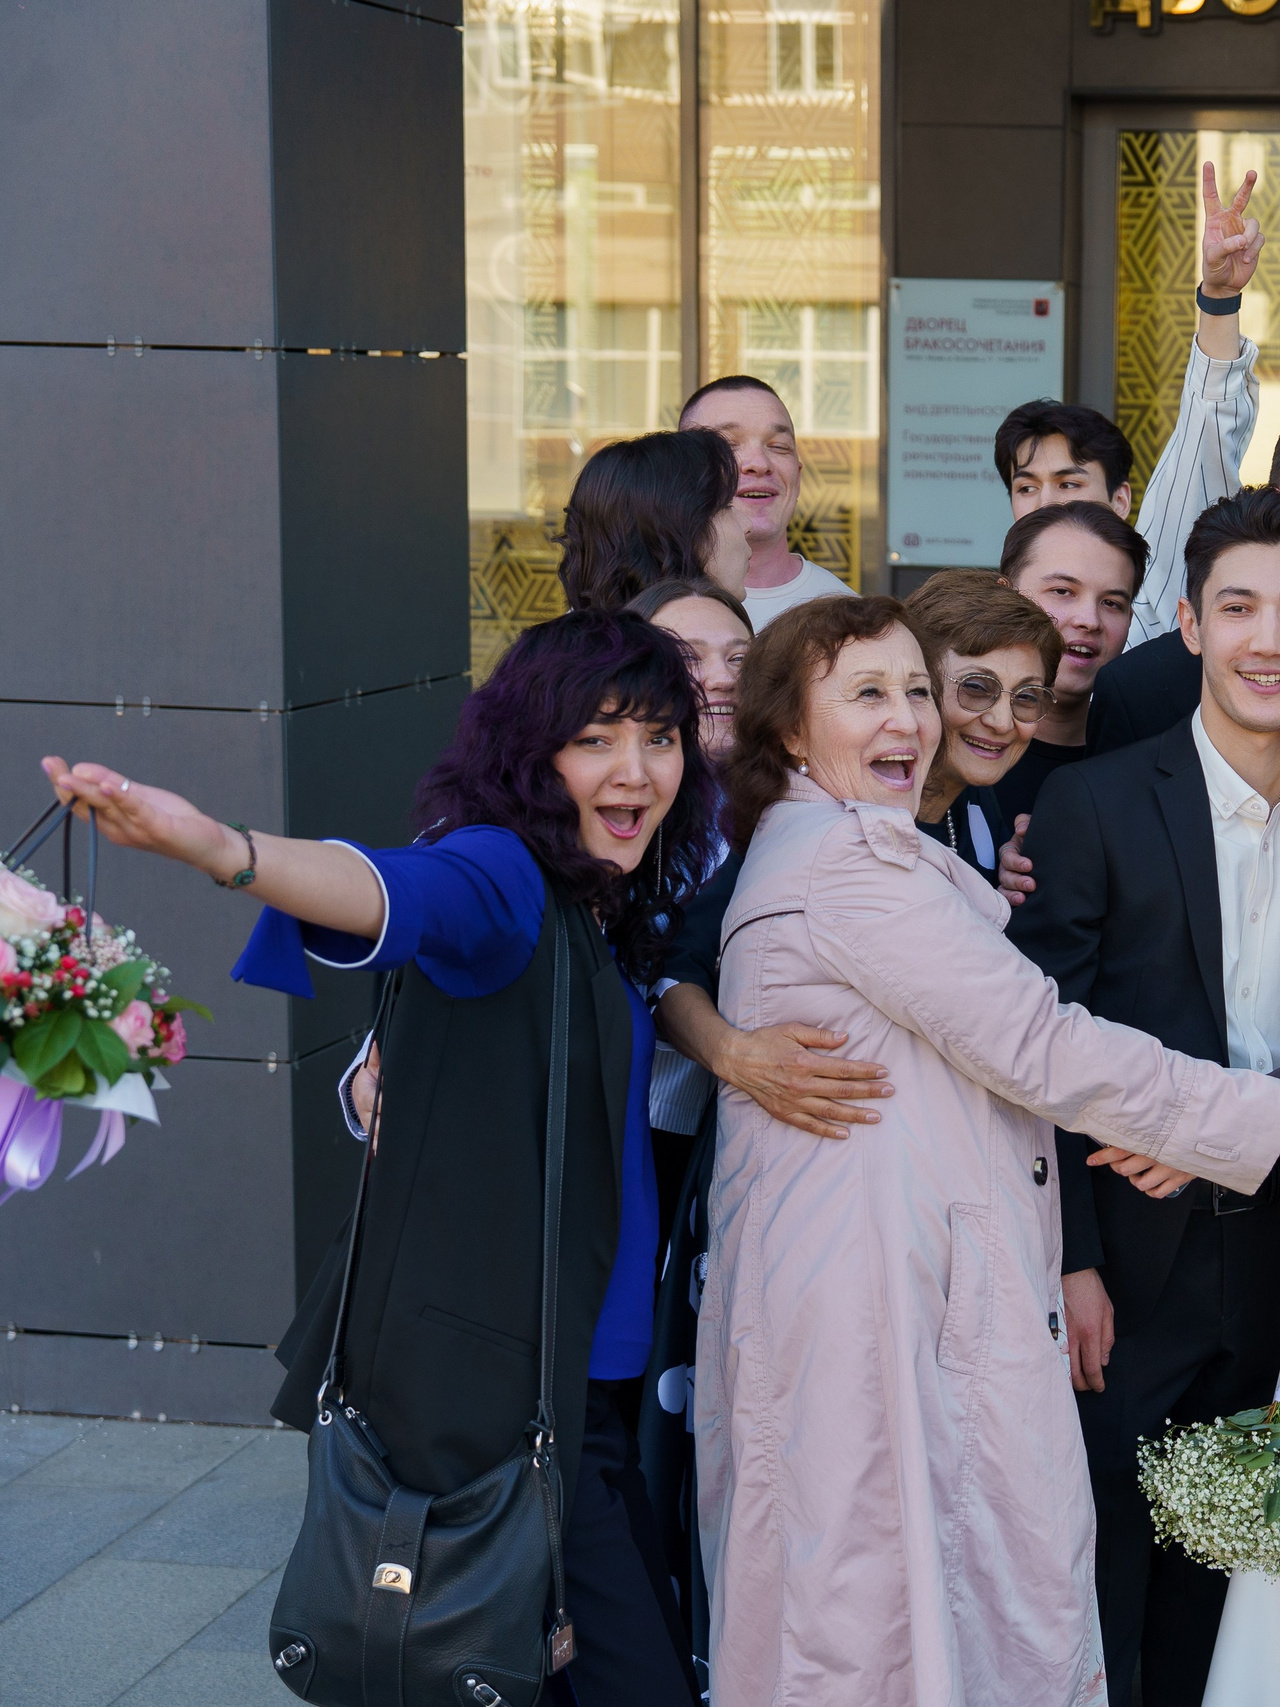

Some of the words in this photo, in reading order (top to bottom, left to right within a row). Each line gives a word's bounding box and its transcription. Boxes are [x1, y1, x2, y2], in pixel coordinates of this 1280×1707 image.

[905, 316, 967, 333] ДВОРЕЦ
[904, 337, 1046, 352] БРАКОСОЧЕТАНИЯ
[902, 429, 995, 445] Государственн
